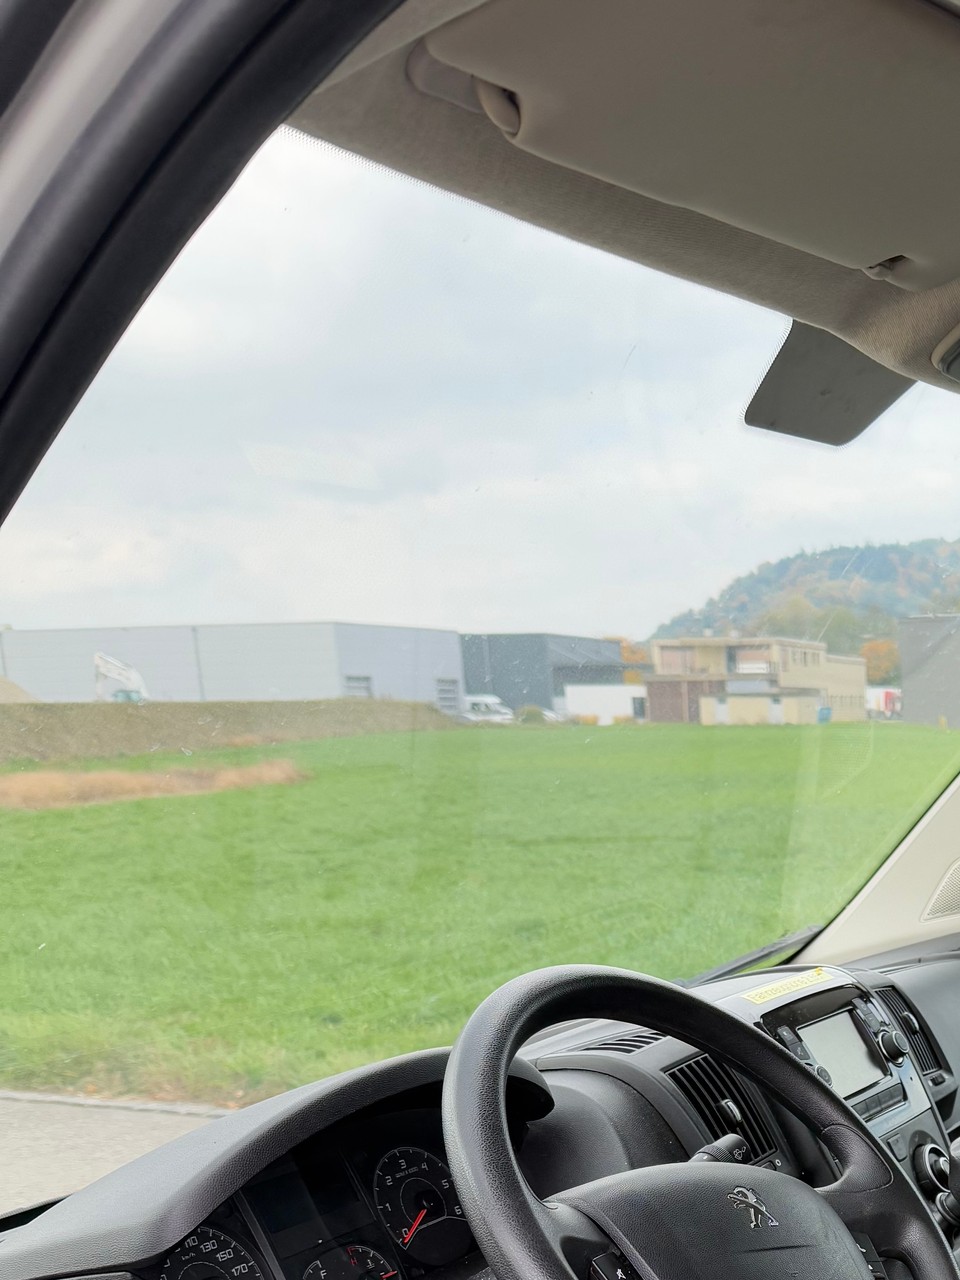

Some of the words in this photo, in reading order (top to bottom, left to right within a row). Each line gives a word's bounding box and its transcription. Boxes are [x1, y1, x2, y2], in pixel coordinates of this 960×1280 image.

[398, 1159, 407, 1169] 3
[421, 1161, 429, 1171] 4
[385, 1175, 393, 1186] 2
[441, 1179, 450, 1189] 5
[454, 1205, 462, 1215] 6
[200, 1239, 218, 1253] 130
[216, 1248, 234, 1262] 150
[231, 1263, 249, 1277] 170
[320, 1269, 327, 1279] F
